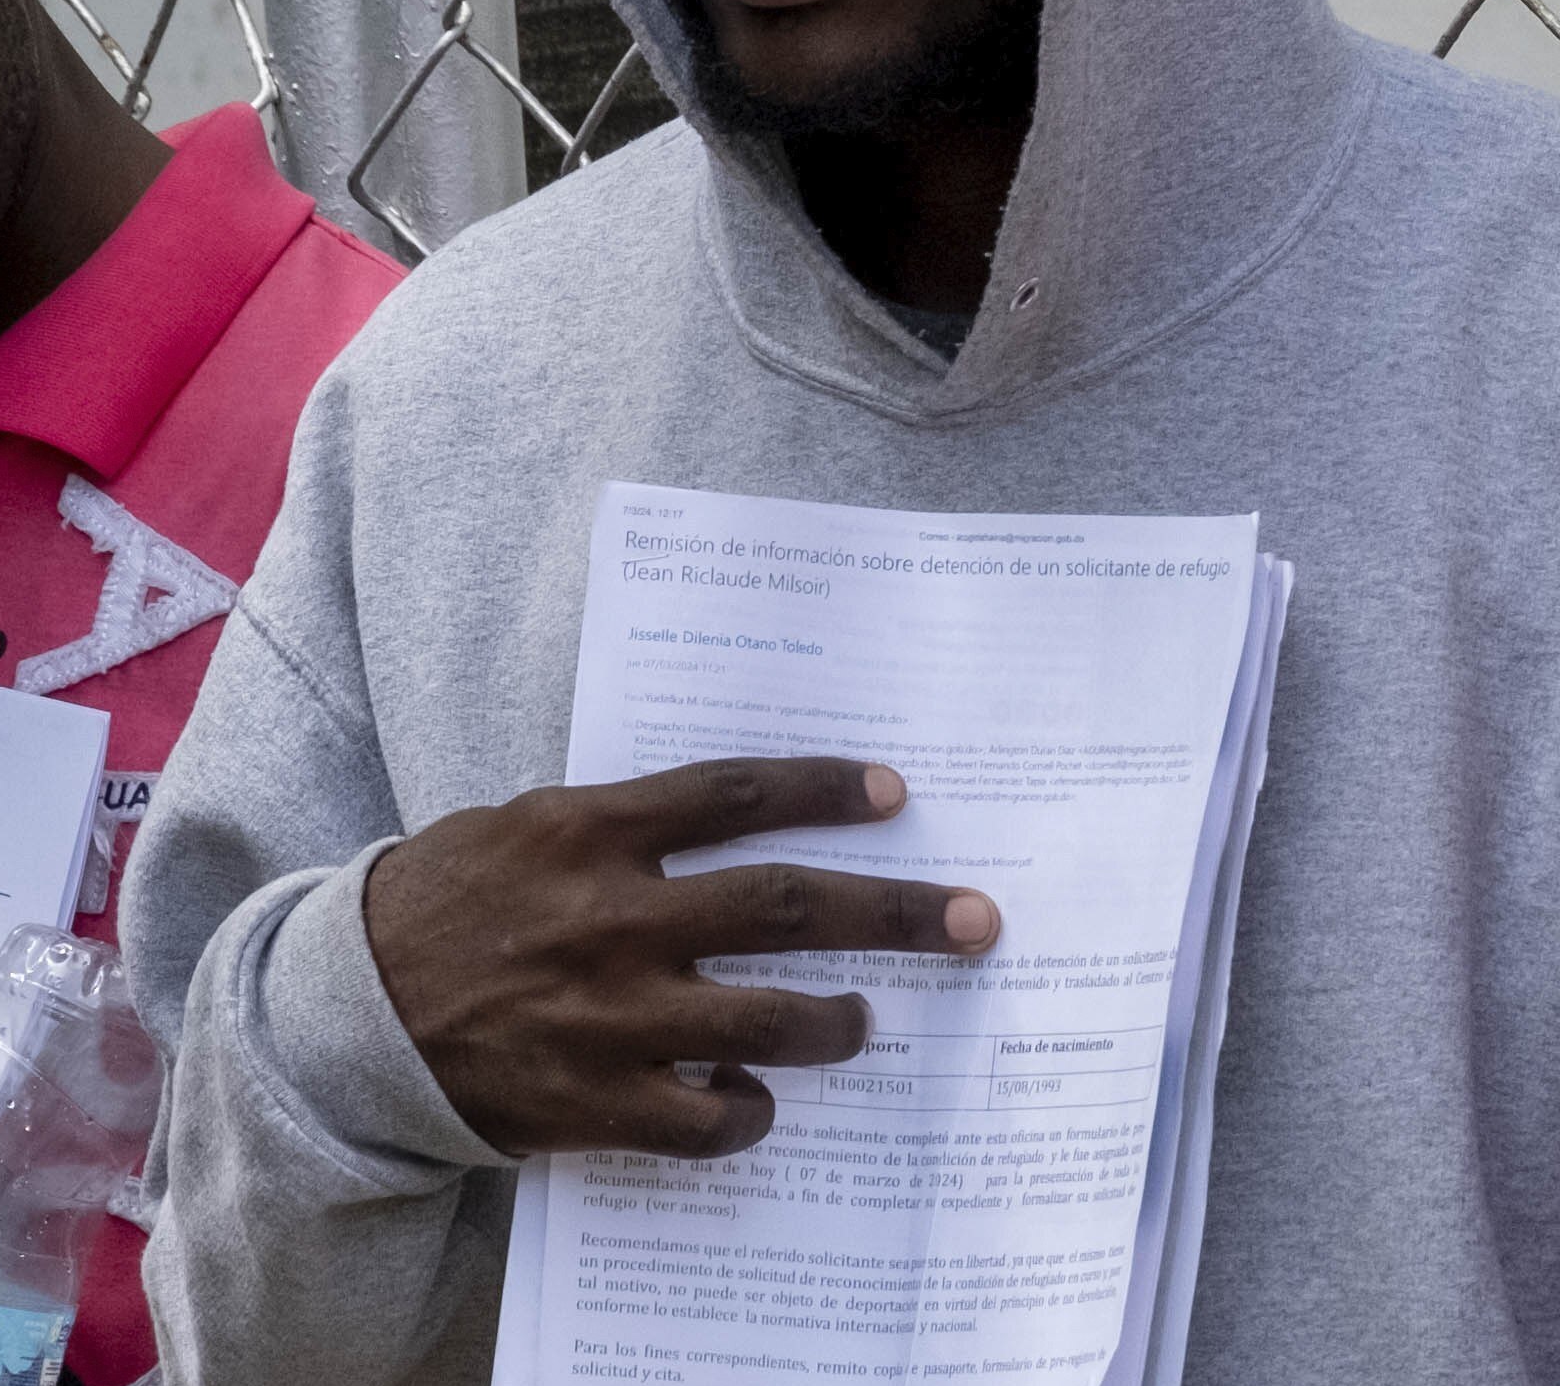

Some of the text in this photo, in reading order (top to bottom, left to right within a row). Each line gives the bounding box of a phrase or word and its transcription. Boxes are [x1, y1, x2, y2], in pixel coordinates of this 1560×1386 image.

[625, 530, 1230, 581] Remisión de información sobre detención de un solicitante de refugio
[623, 561, 831, 599] (Jean Riclaude Milsoir)
[628, 627, 823, 656] Jisselle Dilenia Otano Toledo
[864, 1038, 1114, 1055] porte Fecha de nacimiento
[581, 1231, 886, 1270] Recomendamos que el referido solicitante
[579, 1256, 816, 1287] un procedimiento de solicitud de
[576, 1297, 830, 1331] conforme lo establece la normativa
[572, 1362, 685, 1383] solicitud y cita.
[574, 1338, 867, 1376] Para los fines correspondientes, remito
